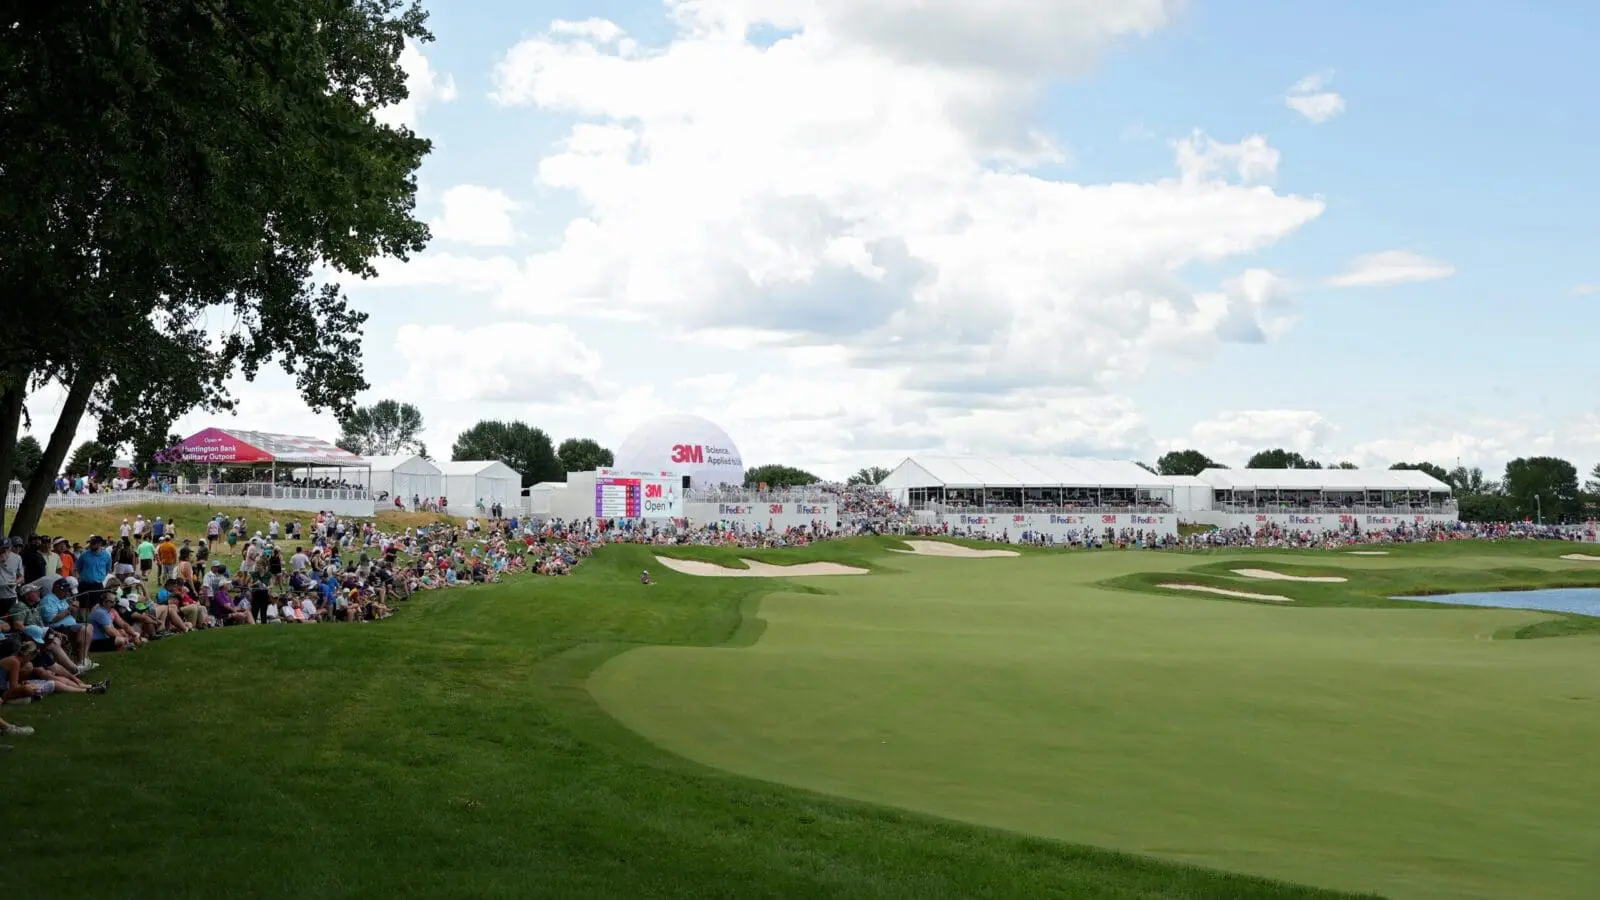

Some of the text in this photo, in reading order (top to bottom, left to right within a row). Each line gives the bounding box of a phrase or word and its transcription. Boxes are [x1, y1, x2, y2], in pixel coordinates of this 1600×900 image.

[671, 444, 703, 463] 3M
[707, 456, 731, 466] Applied
[645, 484, 662, 498] 3M
[644, 500, 666, 512] Open
[725, 505, 745, 514] FedEx
[769, 504, 783, 514] 3M
[803, 505, 821, 514] FedEx
[967, 516, 988, 525] FedEx
[1056, 516, 1077, 524] FedEx
[1102, 515, 1116, 524] 3M
[1137, 516, 1157, 524] FedEx
[1296, 516, 1315, 524] FedEx
[1338, 515, 1352, 524] 3M
[1372, 516, 1392, 524] FedEx
